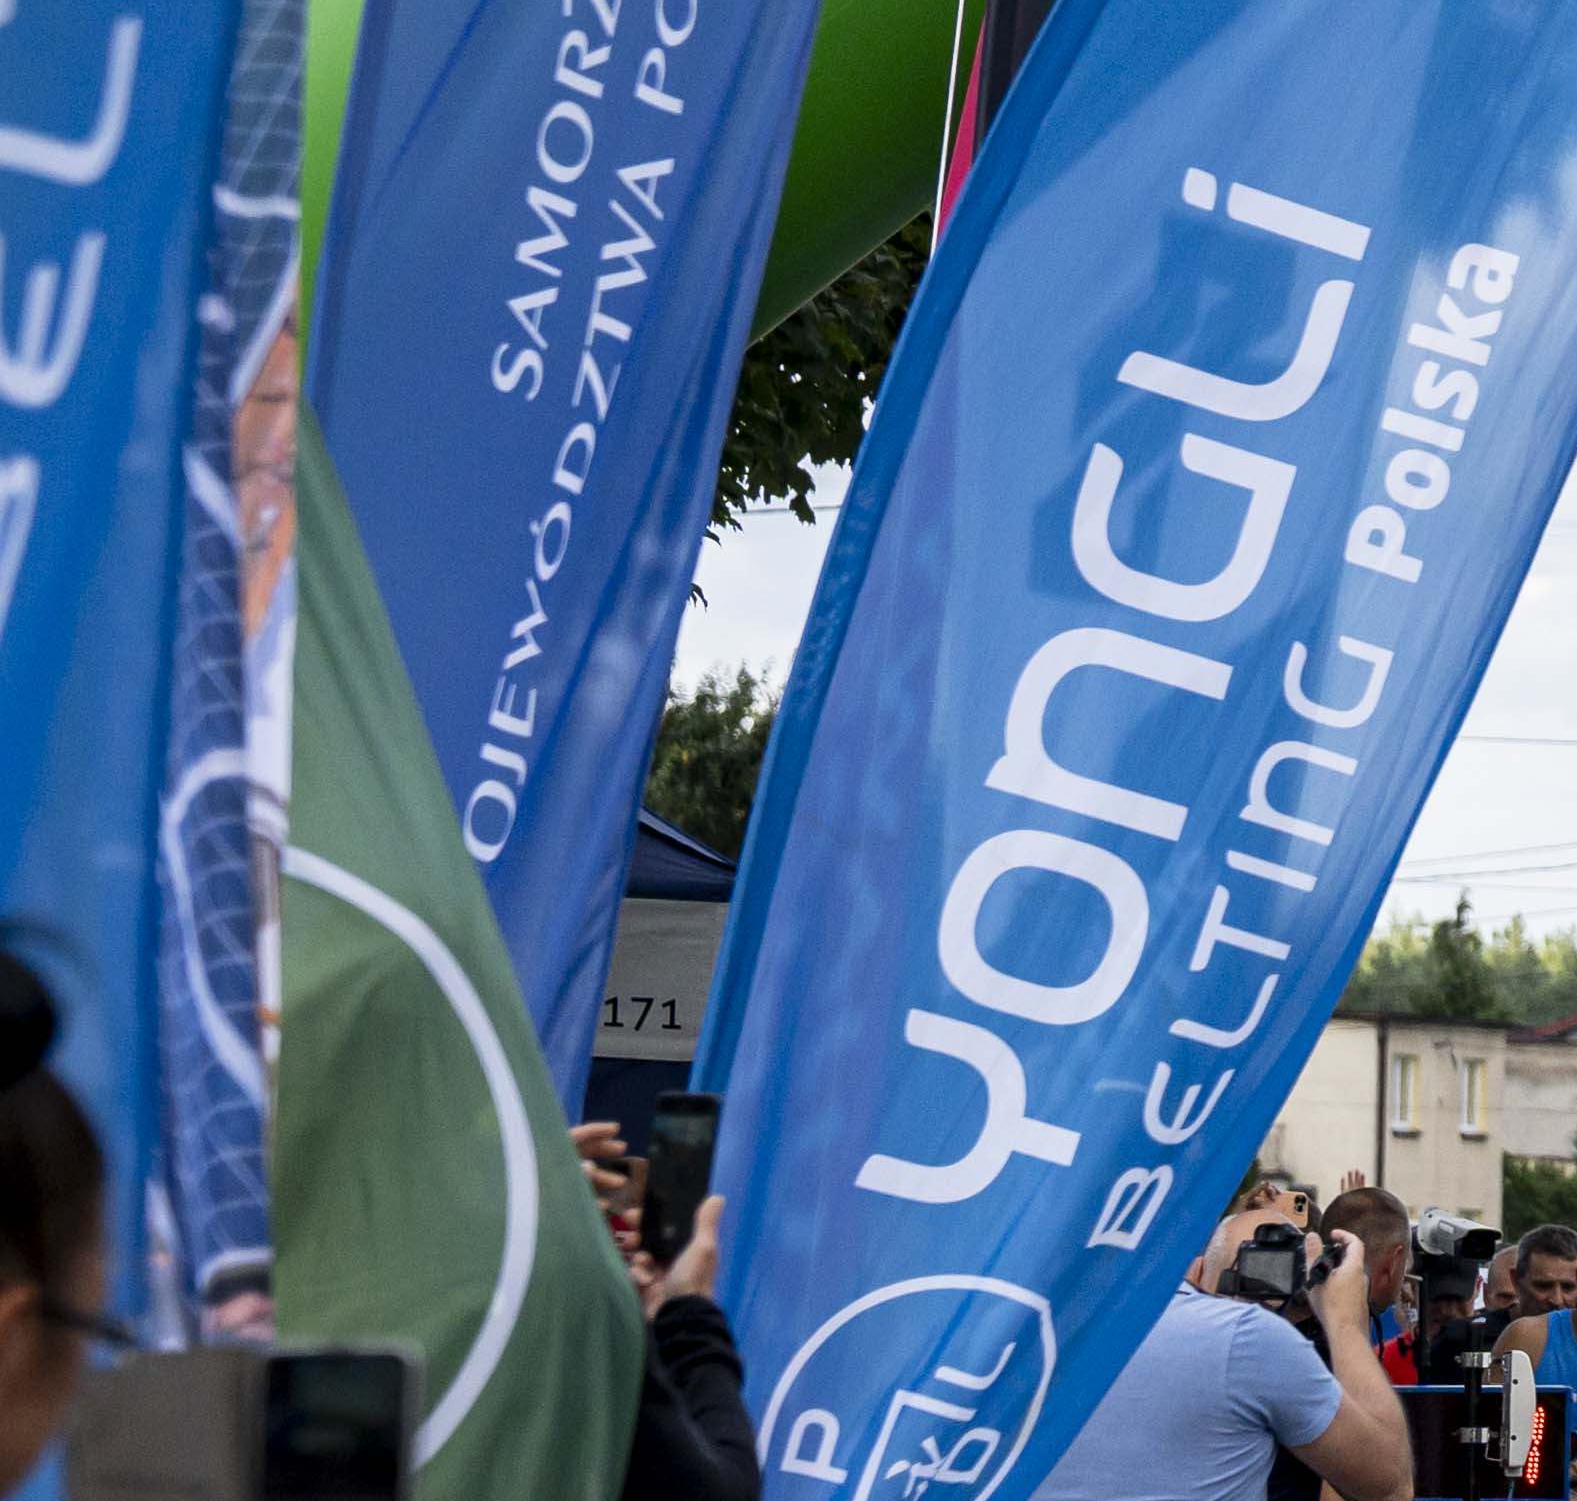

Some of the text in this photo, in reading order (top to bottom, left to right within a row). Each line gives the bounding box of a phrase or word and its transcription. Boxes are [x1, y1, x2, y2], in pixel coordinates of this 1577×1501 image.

[463, 158, 675, 864] OJEWÓDZTWA
[1343, 241, 1520, 583] Polska
[603, 996, 682, 1031] 171
